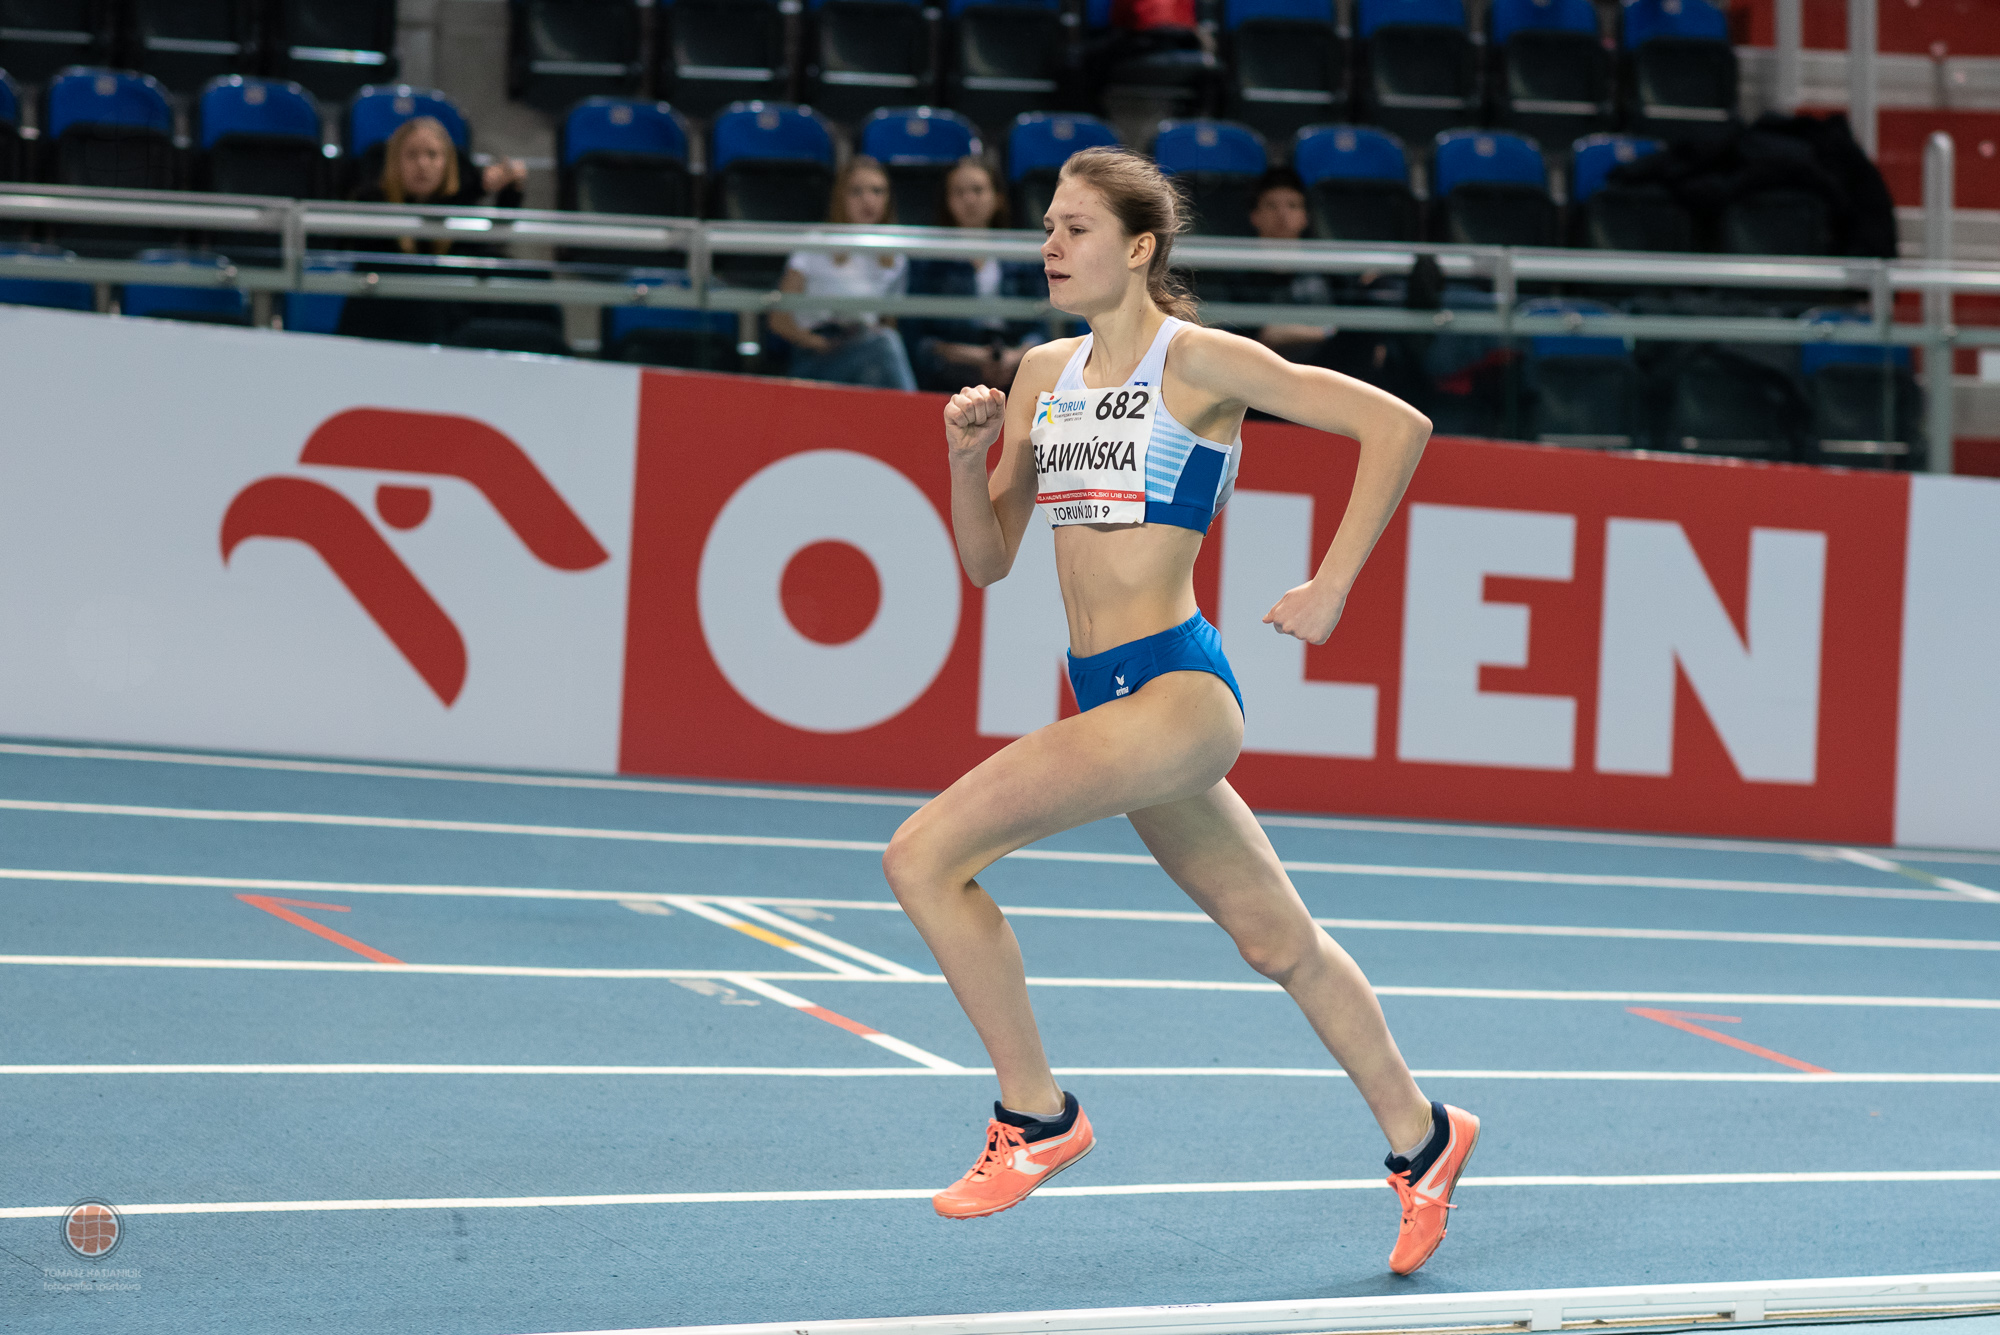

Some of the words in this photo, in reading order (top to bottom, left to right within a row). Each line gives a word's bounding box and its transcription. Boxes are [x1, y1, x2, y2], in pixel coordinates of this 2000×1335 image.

[1058, 397, 1086, 413] TORUŃ
[1095, 390, 1150, 421] 682
[1034, 435, 1136, 474] SŁAWIŃSKA
[1053, 501, 1084, 521] TORUŃ
[1084, 505, 1110, 519] 2019
